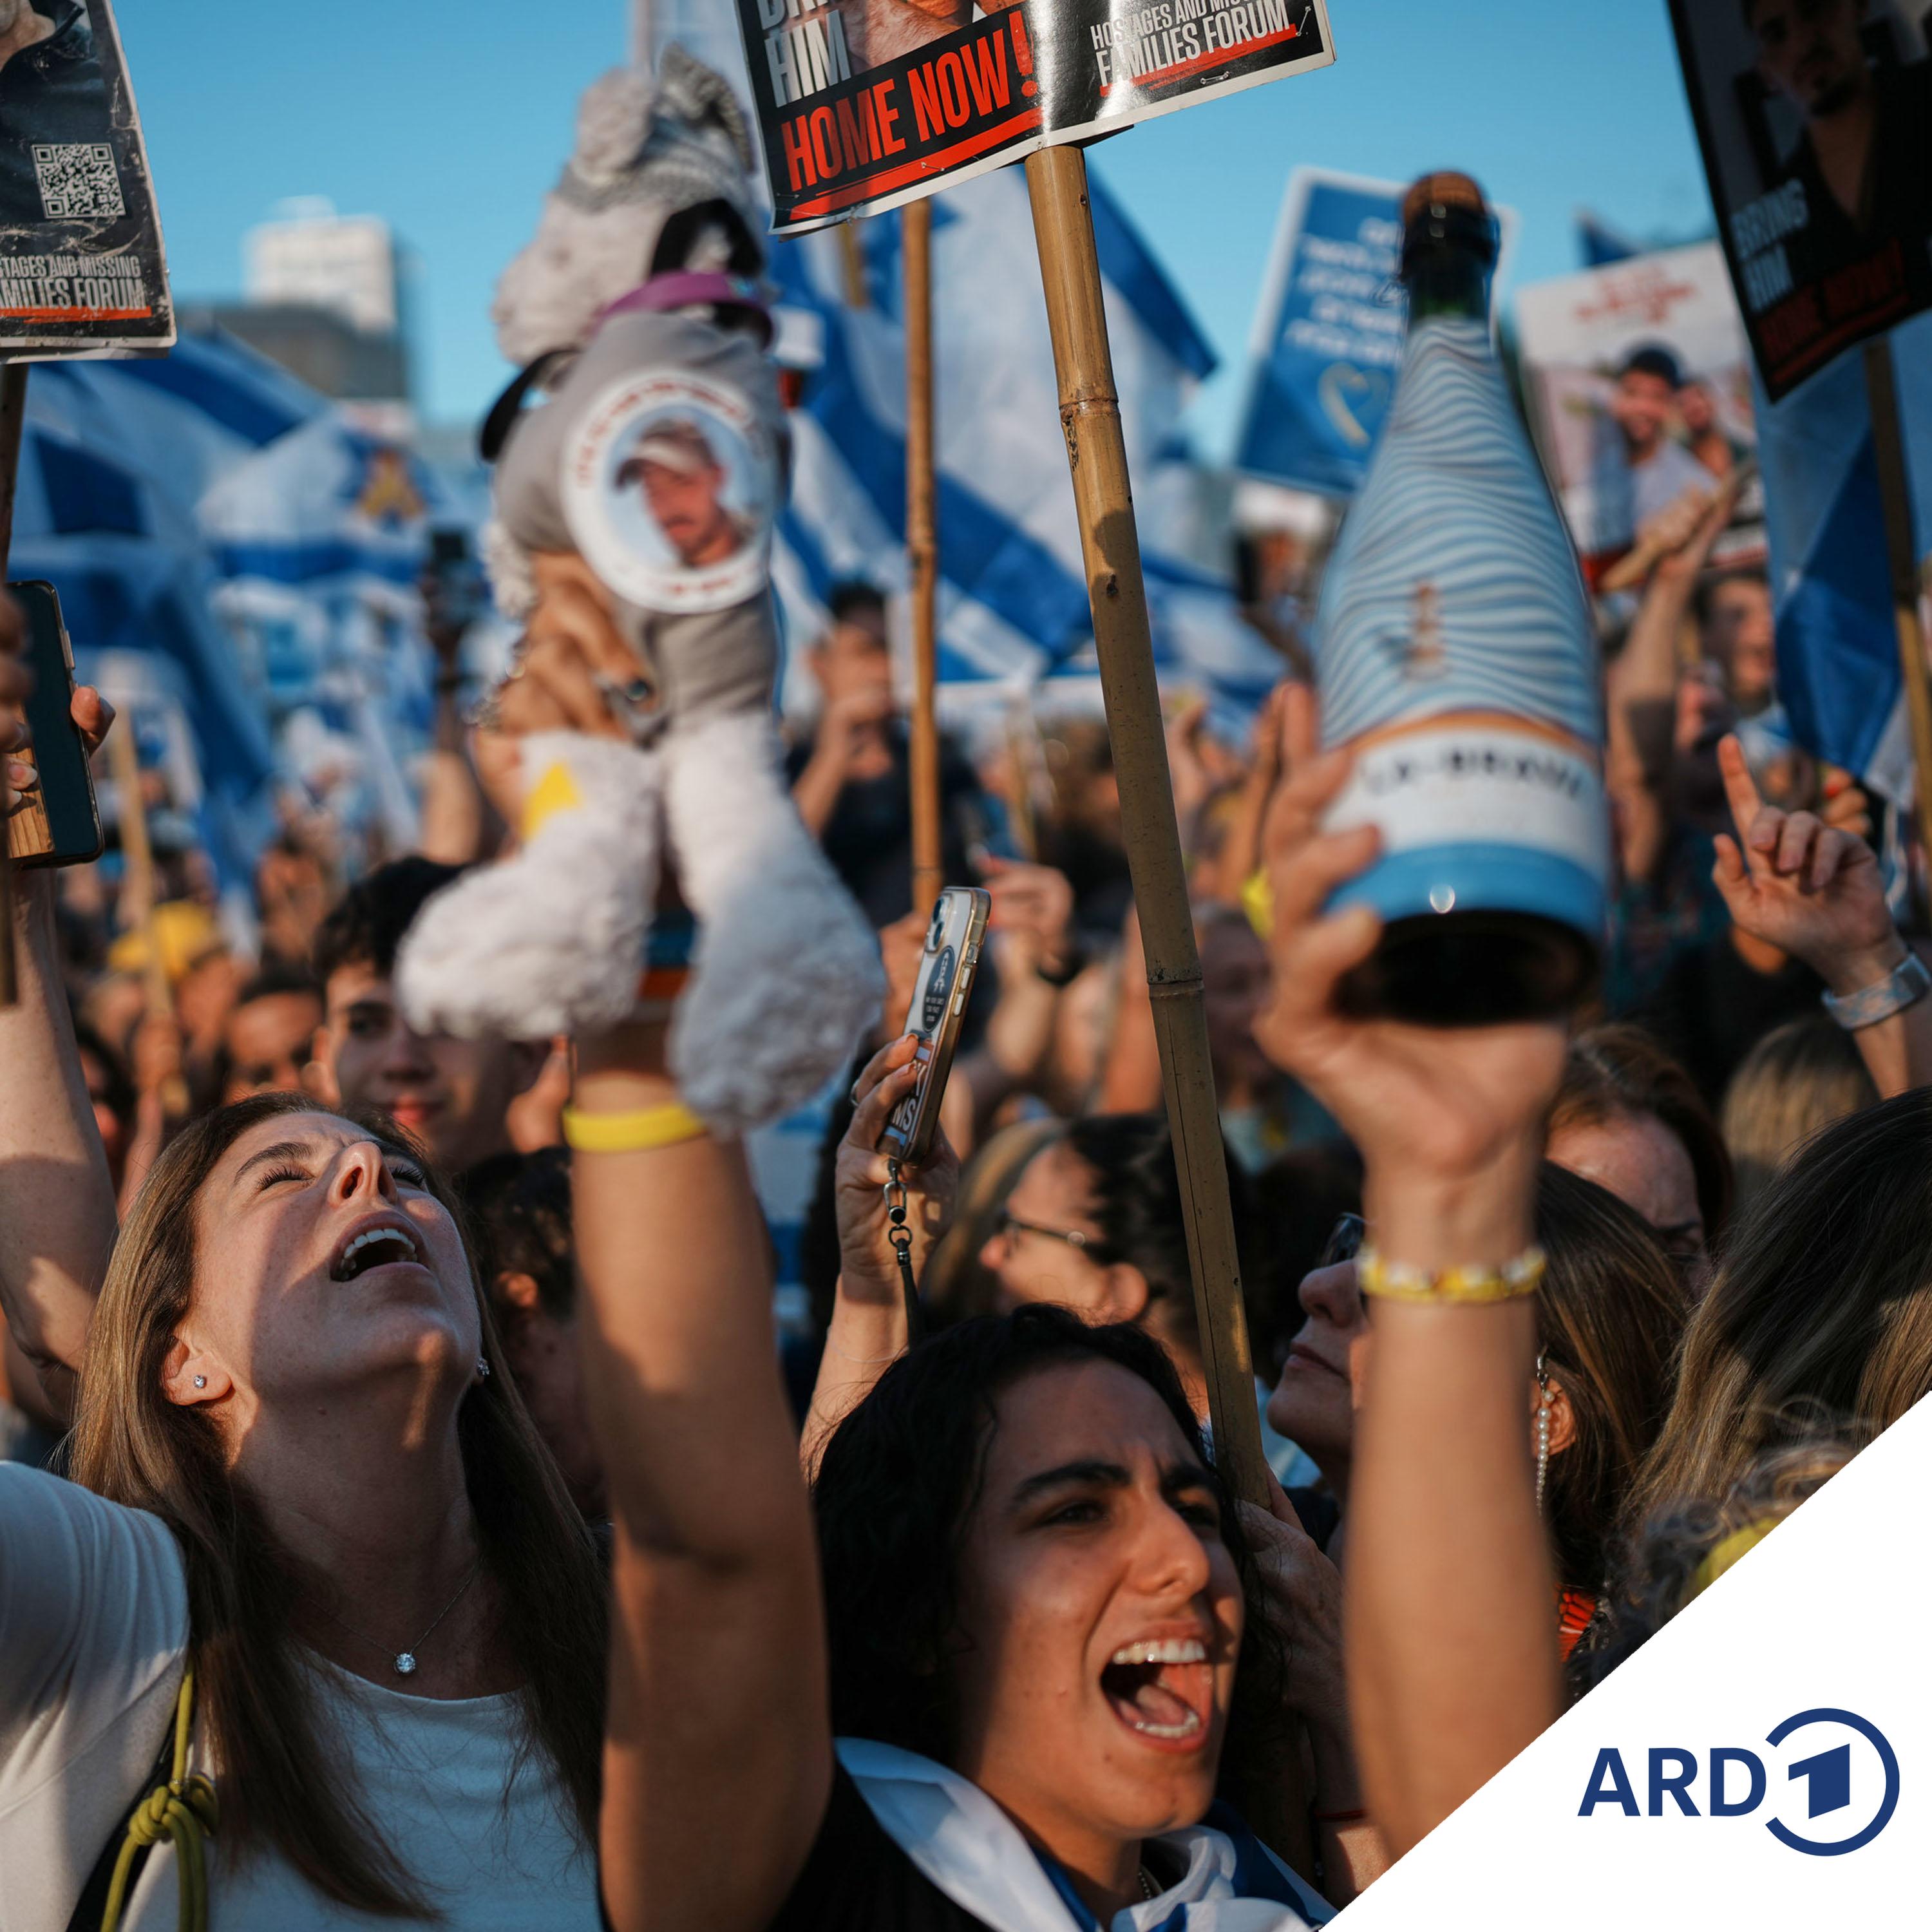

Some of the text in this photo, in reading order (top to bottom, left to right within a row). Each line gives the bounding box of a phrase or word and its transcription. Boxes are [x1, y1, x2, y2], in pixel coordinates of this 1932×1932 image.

[764, 10, 851, 108] HIM
[1090, 0, 1207, 50] HOSTAGES AND
[1095, 0, 1291, 87] FAMILIES FORUM
[781, 78, 906, 192] HOME
[48, 255, 79, 278] AND
[80, 255, 142, 278] MISSING
[73, 278, 147, 310] FORUM
